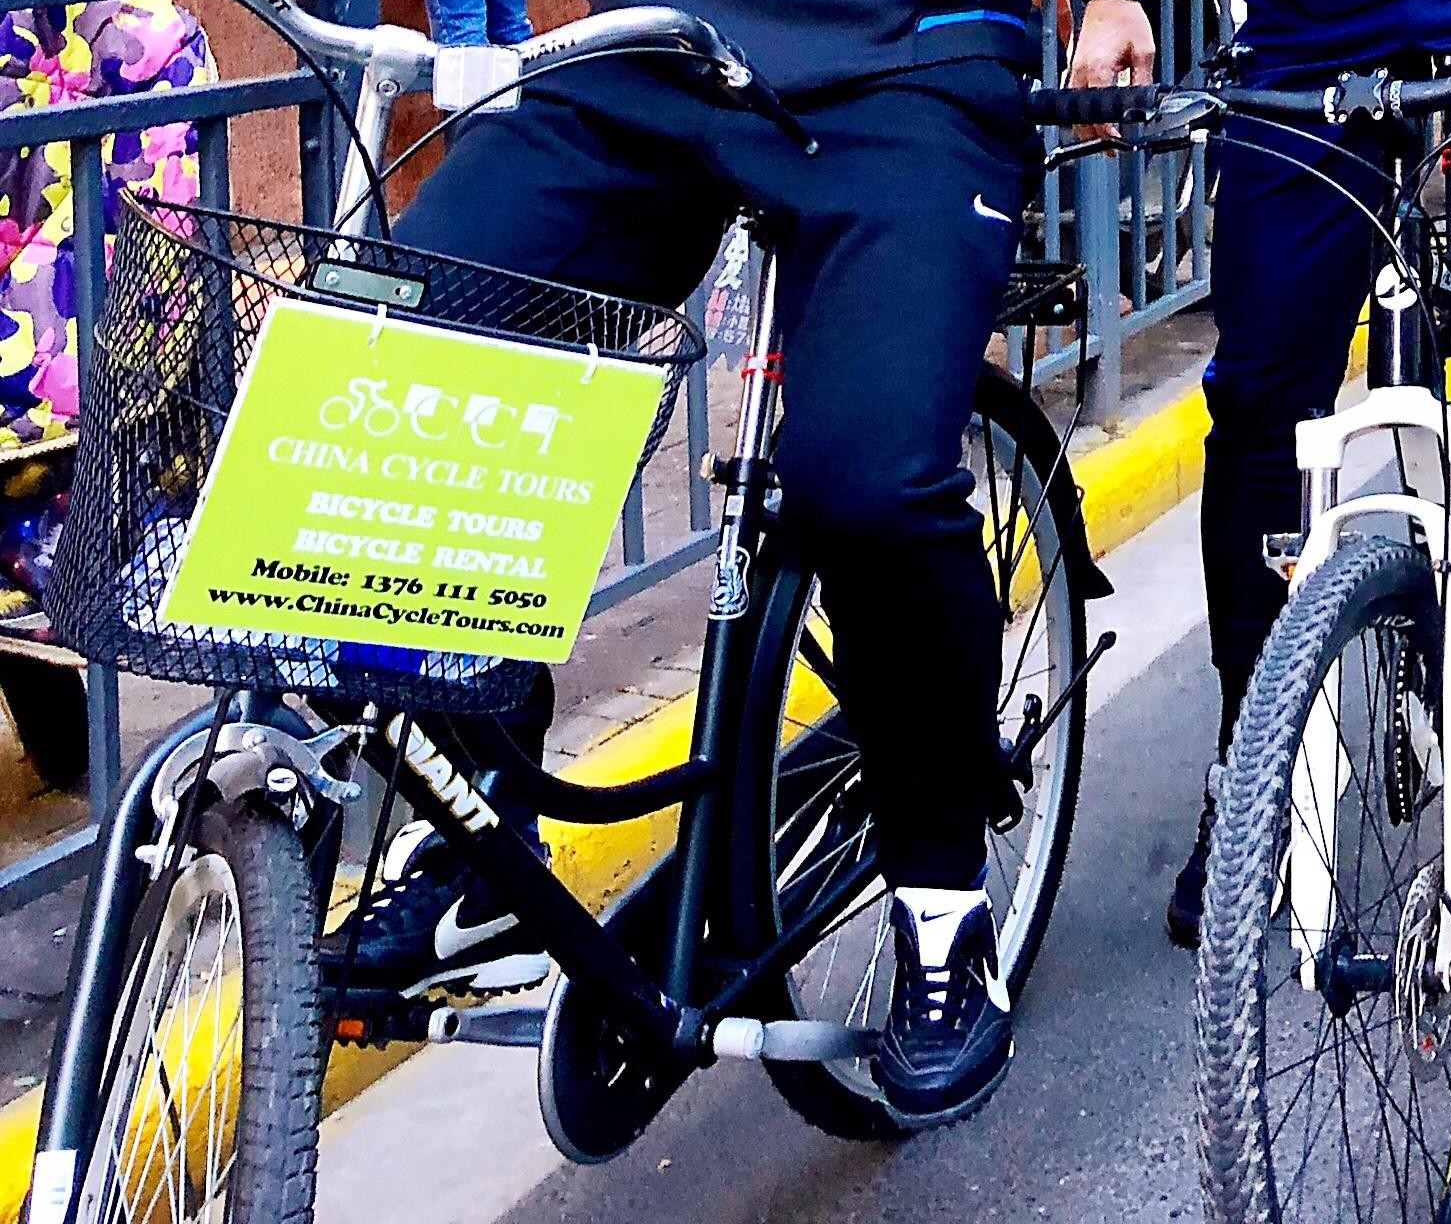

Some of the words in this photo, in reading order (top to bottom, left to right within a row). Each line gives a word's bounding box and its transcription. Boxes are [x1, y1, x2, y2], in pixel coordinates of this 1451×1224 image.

[268, 436, 369, 474] CHINA
[381, 453, 488, 490] CYCLE
[498, 468, 594, 504] TOURS
[306, 491, 437, 527] BICYCLE
[448, 510, 545, 541] TOURS
[292, 528, 424, 564] BICYCLE
[431, 546, 548, 578] RENTAL
[251, 558, 350, 587] Mobile:
[361, 575, 423, 595] 1376
[433, 582, 478, 601] 111
[488, 589, 547, 608] 5050
[208, 588, 565, 639] www.ChinaCycleTours.com
[385, 712, 500, 834] GIANT
